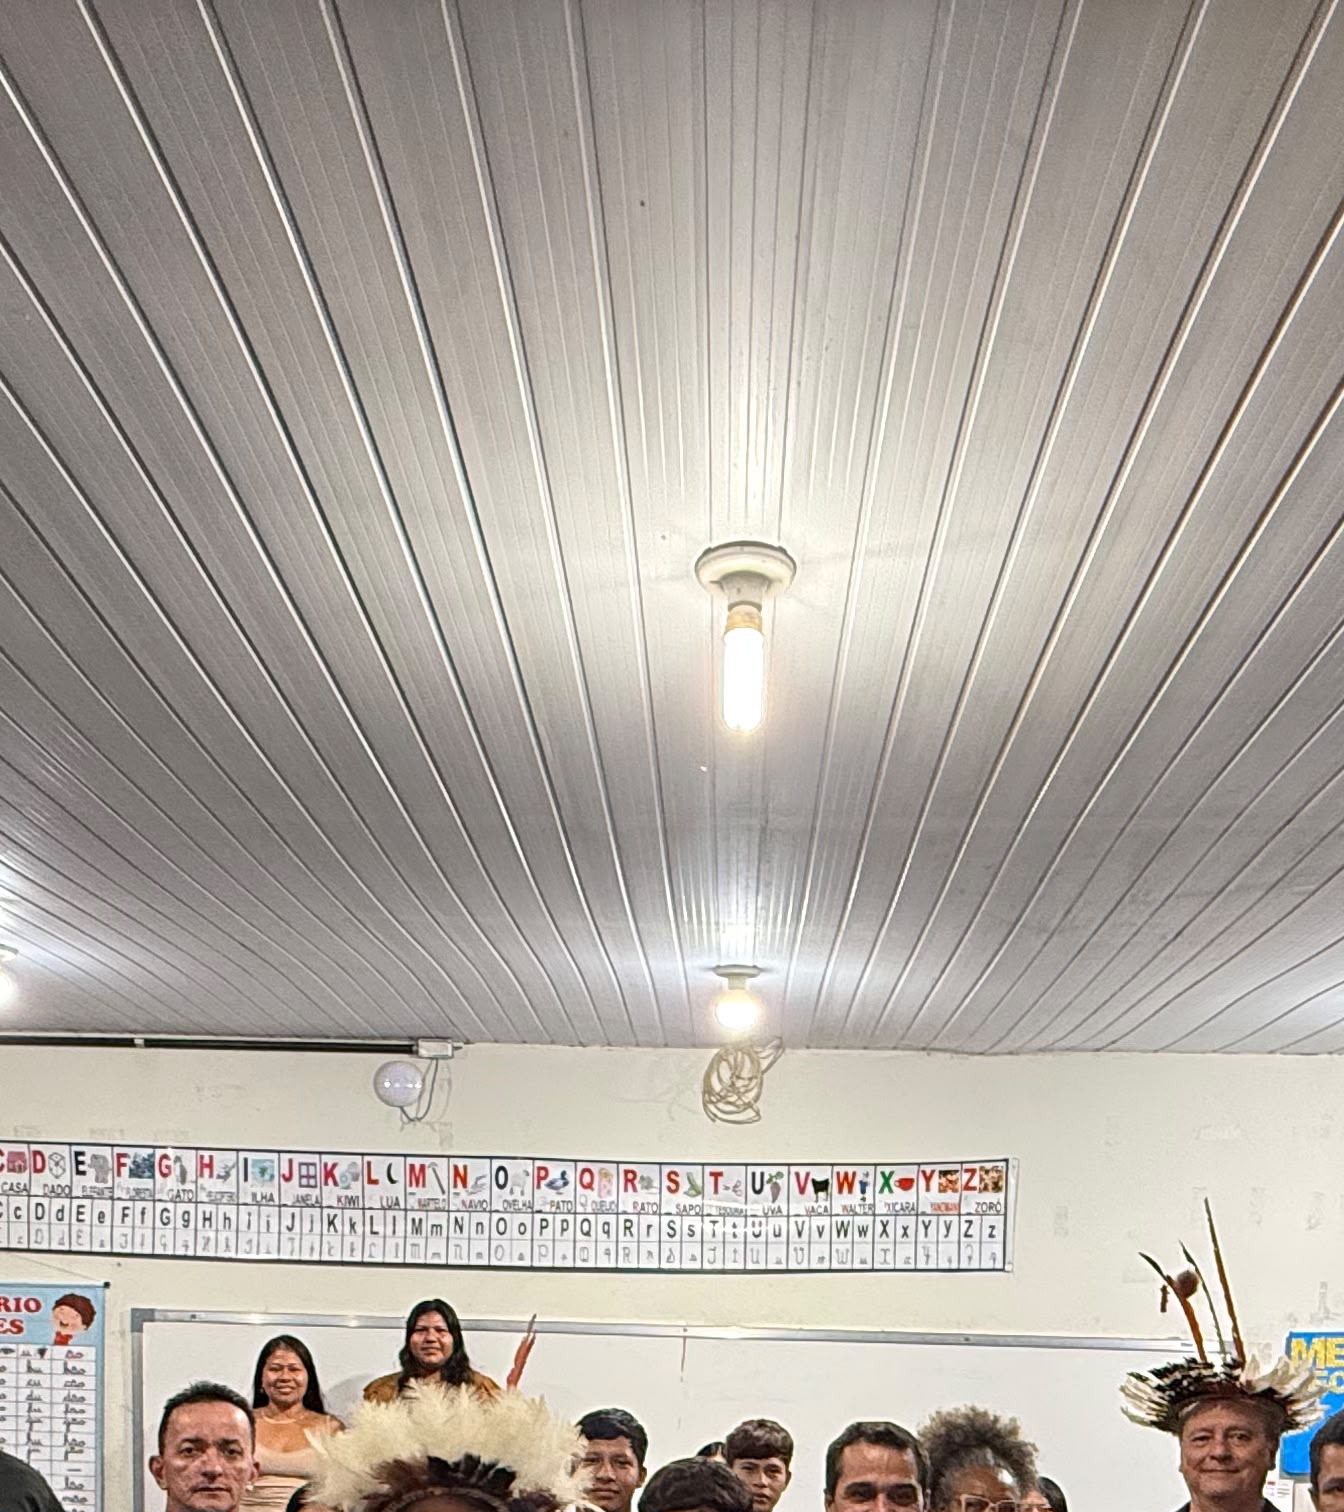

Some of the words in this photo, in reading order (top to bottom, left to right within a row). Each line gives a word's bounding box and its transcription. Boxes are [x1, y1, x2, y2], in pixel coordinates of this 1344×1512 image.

[32, 1151, 46, 1173] D
[75, 1151, 86, 1176] E
[116, 1153, 128, 1177] F
[159, 1154, 172, 1178] G
[199, 1155, 214, 1178] H
[244, 1158, 248, 1182] I
[282, 1158, 293, 1182] J
[324, 1162, 339, 1186] K
[367, 1161, 379, 1185] L
[409, 1164, 426, 1188] M
[454, 1165, 467, 1189] N
[495, 1166, 508, 1190] O
[536, 1166, 549, 1189] P
[579, 1168, 595, 1191] Q
[624, 1169, 637, 1192] R
[667, 1171, 679, 1194] S
[710, 1172, 723, 1194] T
[752, 1172, 765, 1194] U
[795, 1172, 810, 1194] V
[836, 1171, 856, 1194] W
[879, 1171, 894, 1194] X
[921, 1170, 936, 1192] Y
[963, 1169, 977, 1191] Z
[1, 1182, 28, 1193] CASA
[43, 1184, 71, 1196] DADO
[168, 1189, 193, 1201] GATO
[252, 1192, 274, 1202] ILHA
[337, 1195, 359, 1207] KIWI
[380, 1197, 400, 1207] LUA
[462, 1199, 488, 1210] NAVIO
[550, 1201, 572, 1213] PATO
[633, 1202, 658, 1213] RATO
[676, 1204, 701, 1214] SAPO
[762, 1204, 783, 1215] UVA
[806, 1204, 828, 1215] VACA
